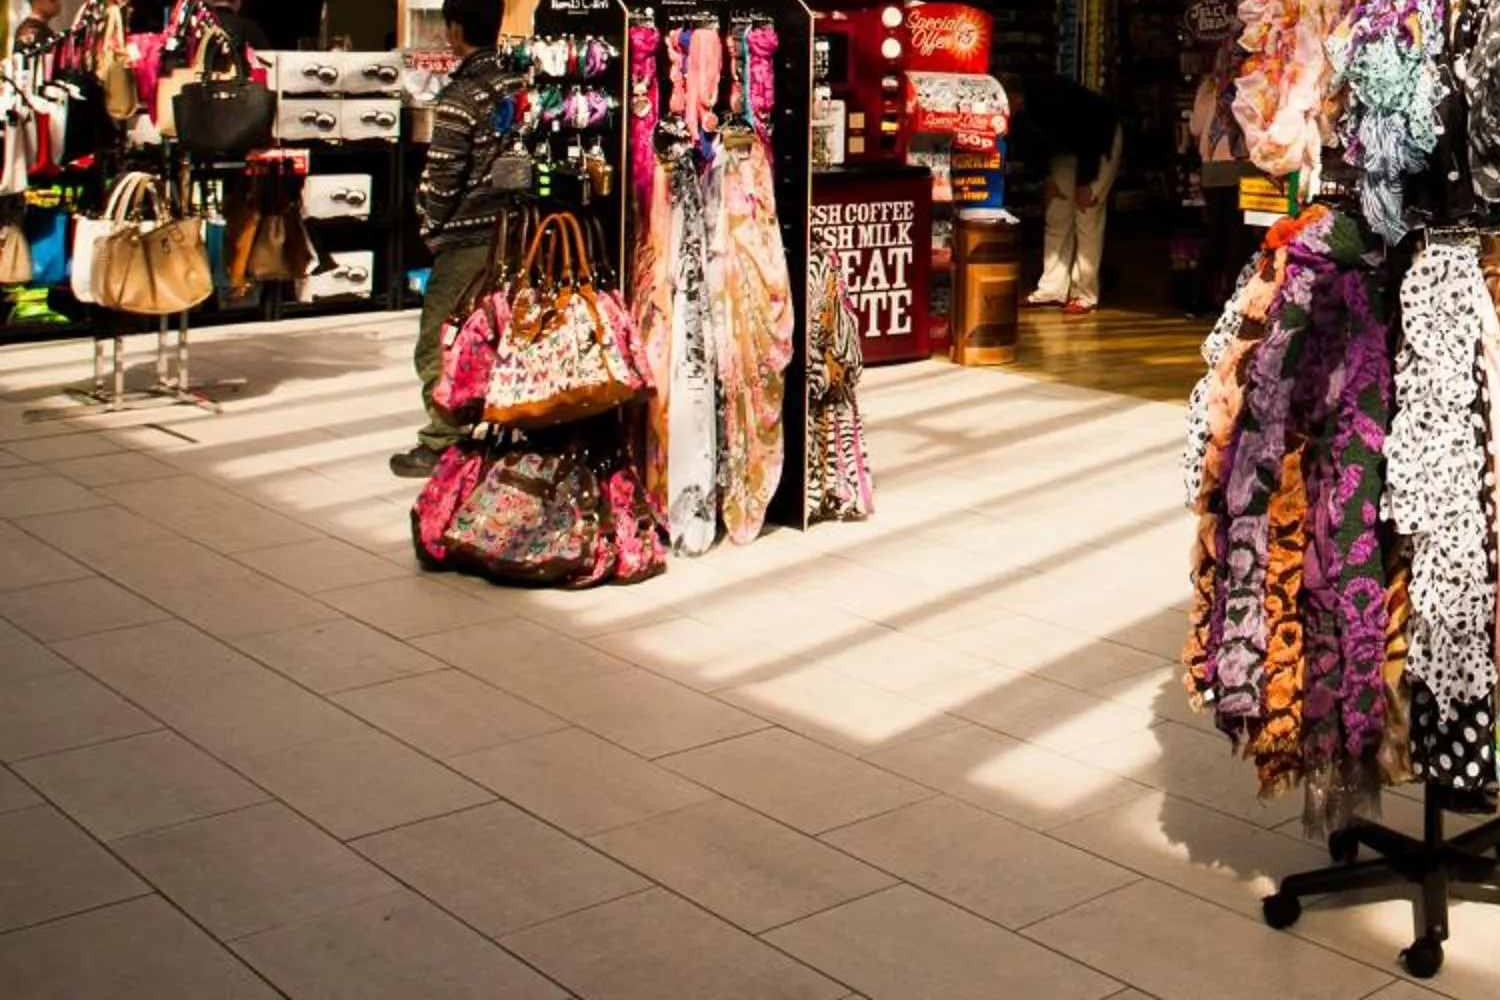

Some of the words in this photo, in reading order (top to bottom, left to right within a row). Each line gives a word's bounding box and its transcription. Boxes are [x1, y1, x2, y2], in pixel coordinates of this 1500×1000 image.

[912, 28, 947, 56] Offe
[846, 201, 914, 223] COFFEE
[858, 222, 913, 248] MILK
[850, 290, 913, 337] TE
